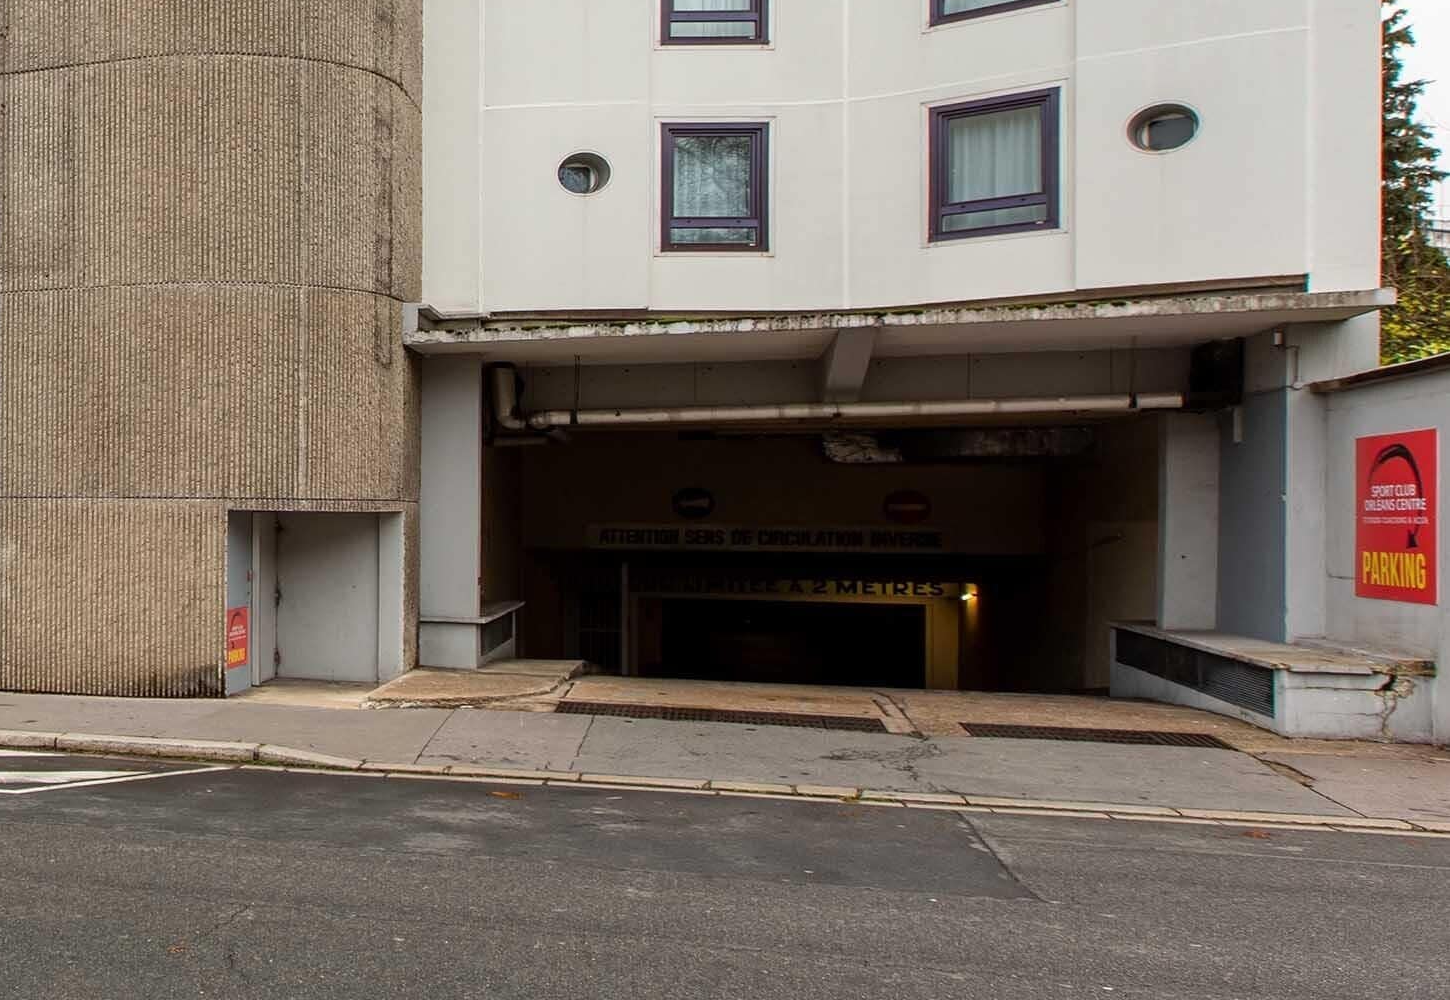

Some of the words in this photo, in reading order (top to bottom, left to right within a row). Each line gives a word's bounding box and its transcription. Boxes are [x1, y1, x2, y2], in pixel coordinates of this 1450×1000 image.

[1371, 484, 1394, 497] SPORT
[1395, 484, 1416, 497] CLUB
[684, 528, 727, 546] SENS
[1362, 551, 1427, 589] PARKING
[812, 580, 828, 595] 2
